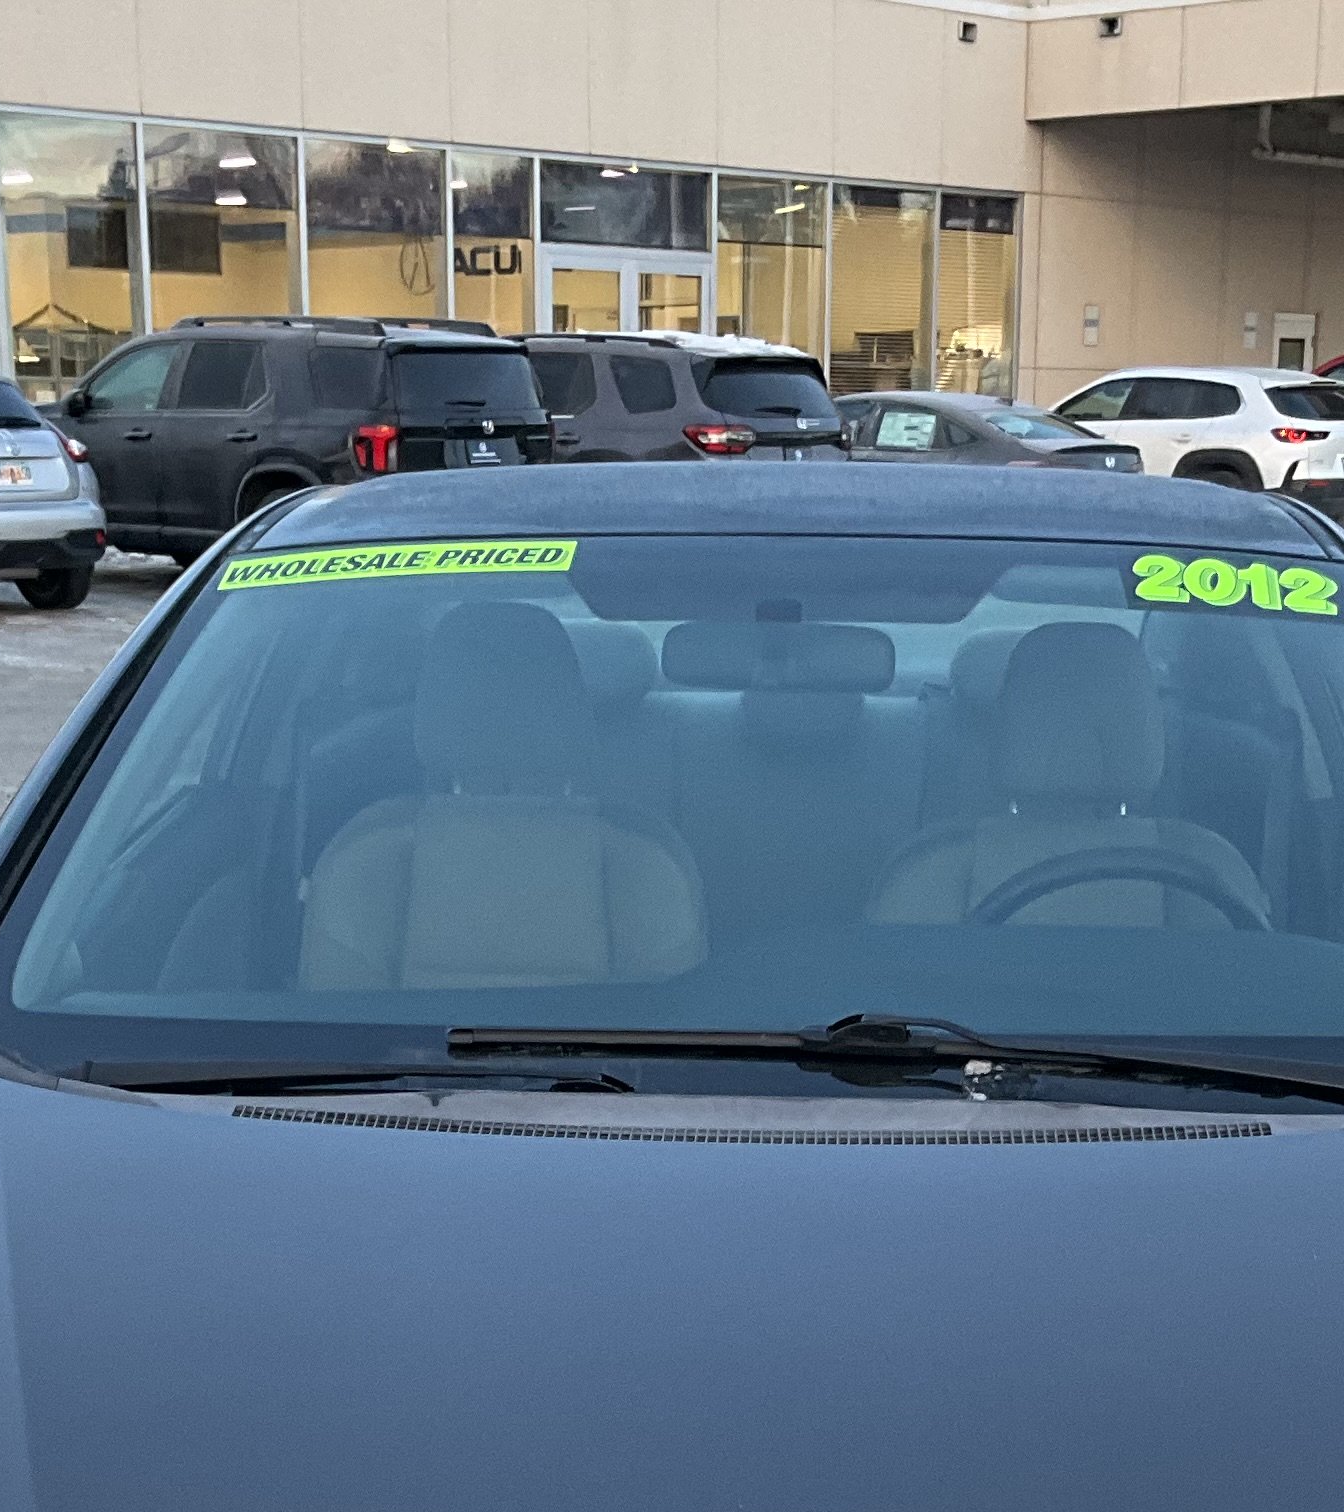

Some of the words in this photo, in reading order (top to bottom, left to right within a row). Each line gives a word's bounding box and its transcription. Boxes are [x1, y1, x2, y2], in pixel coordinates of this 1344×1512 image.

[453, 245, 521, 276] ACU
[225, 550, 432, 584] WHOLESALE
[437, 547, 568, 568] PRICED
[1132, 554, 1339, 616] 2012
